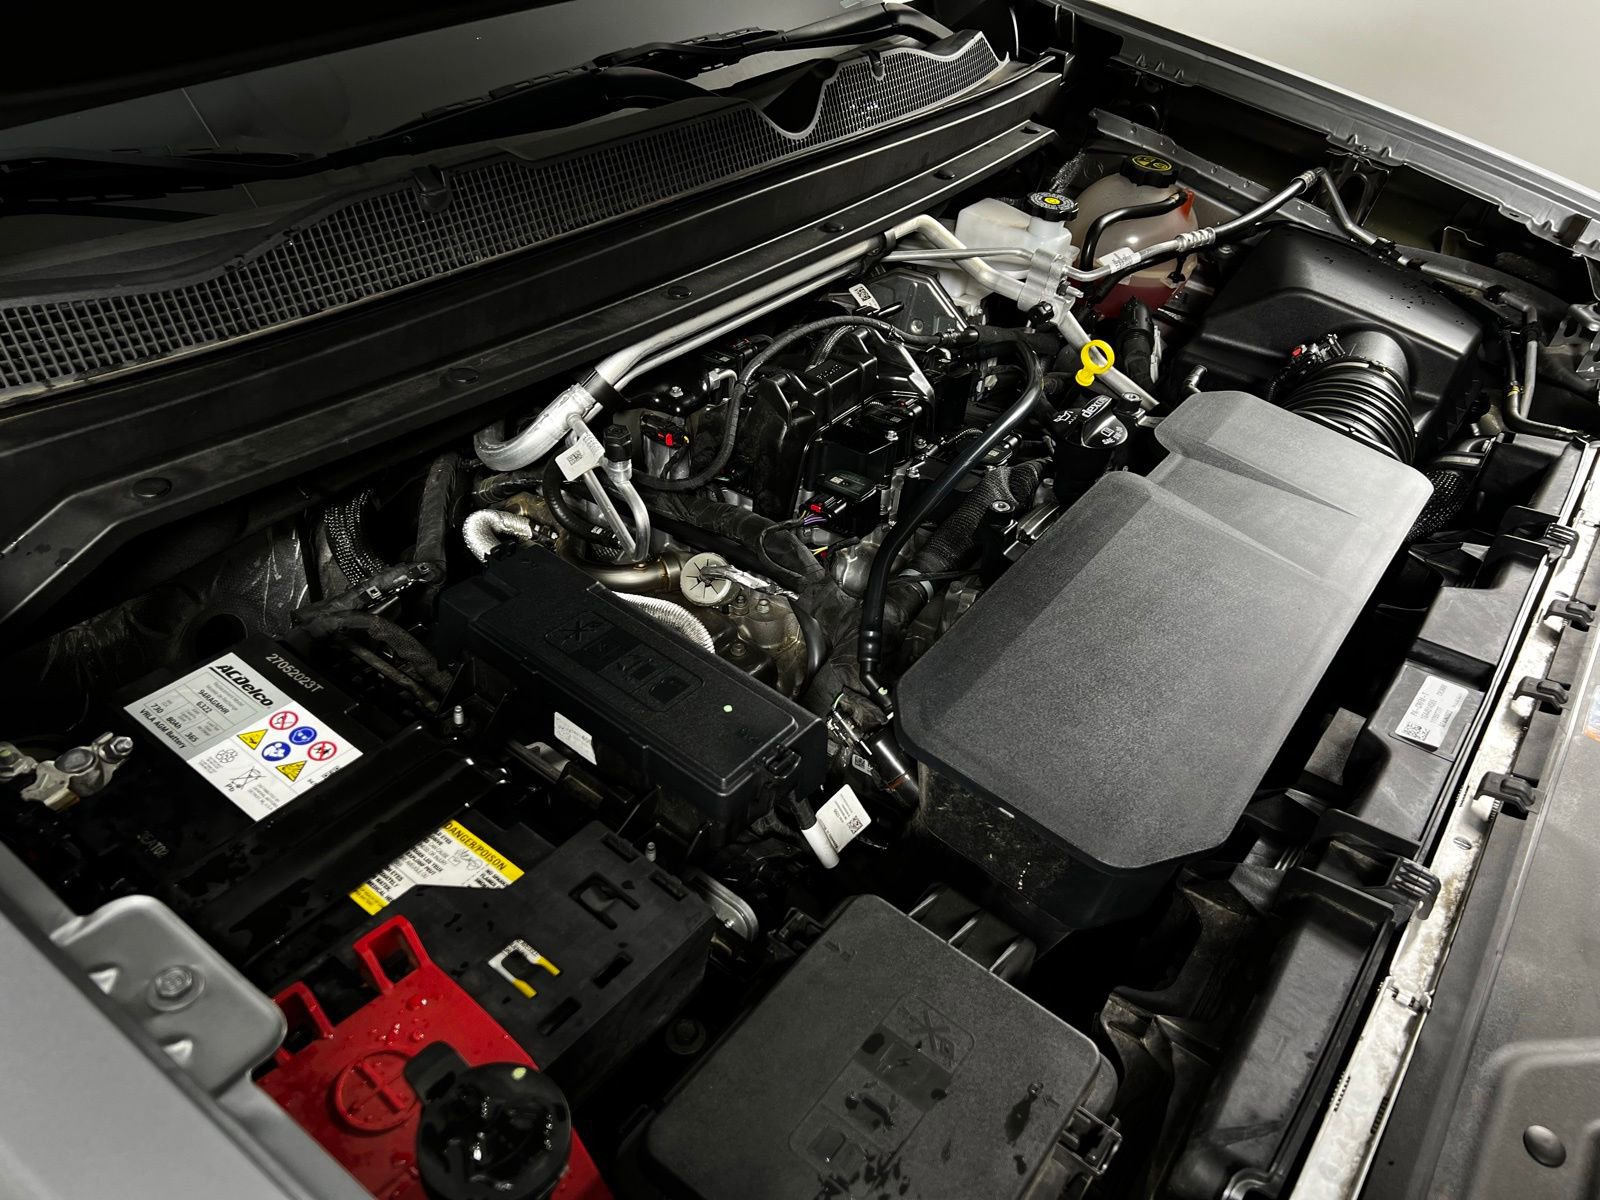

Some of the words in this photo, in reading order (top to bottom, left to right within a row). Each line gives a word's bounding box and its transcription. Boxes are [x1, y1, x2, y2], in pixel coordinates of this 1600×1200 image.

[215, 663, 275, 707] ACDelco
[265, 653, 325, 693] 27052023T
[150, 703, 164, 713] 730
[195, 701, 212, 713] 6322
[138, 708, 156, 721] VRLA
[153, 720, 169, 732] AGM
[164, 731, 188, 748] Battery
[184, 732, 199, 742] 365
[445, 823, 507, 870] DANGER/POISON
[390, 871, 403, 881] EYES
